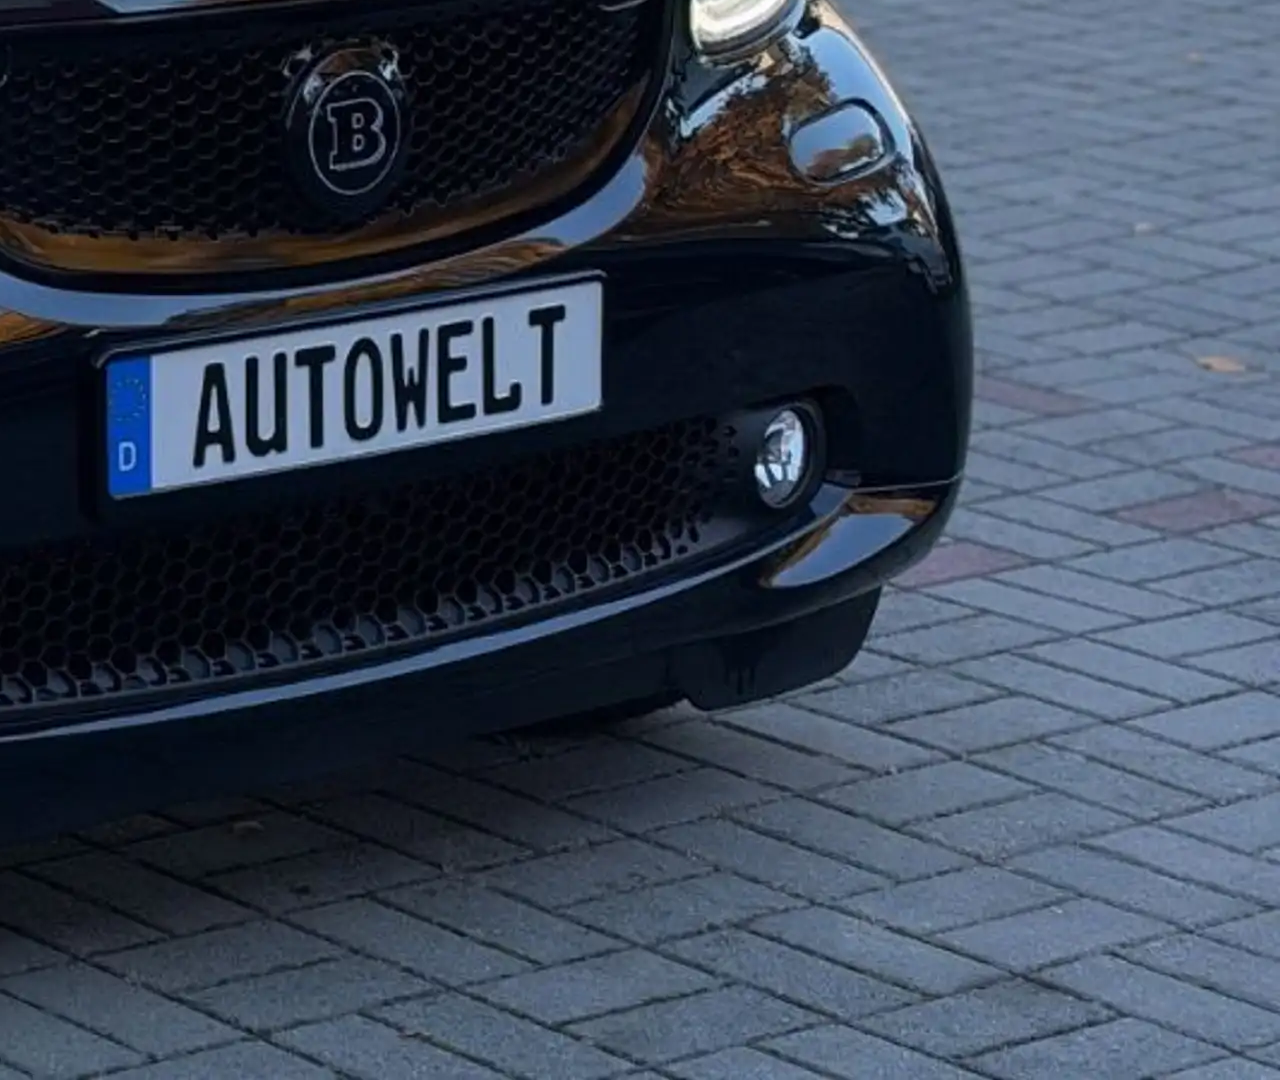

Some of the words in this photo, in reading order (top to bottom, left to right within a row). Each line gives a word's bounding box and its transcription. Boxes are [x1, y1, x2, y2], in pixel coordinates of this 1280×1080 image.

[326, 97, 387, 171] B
[118, 441, 137, 472] D
[192, 304, 566, 468] AUTOWELT
